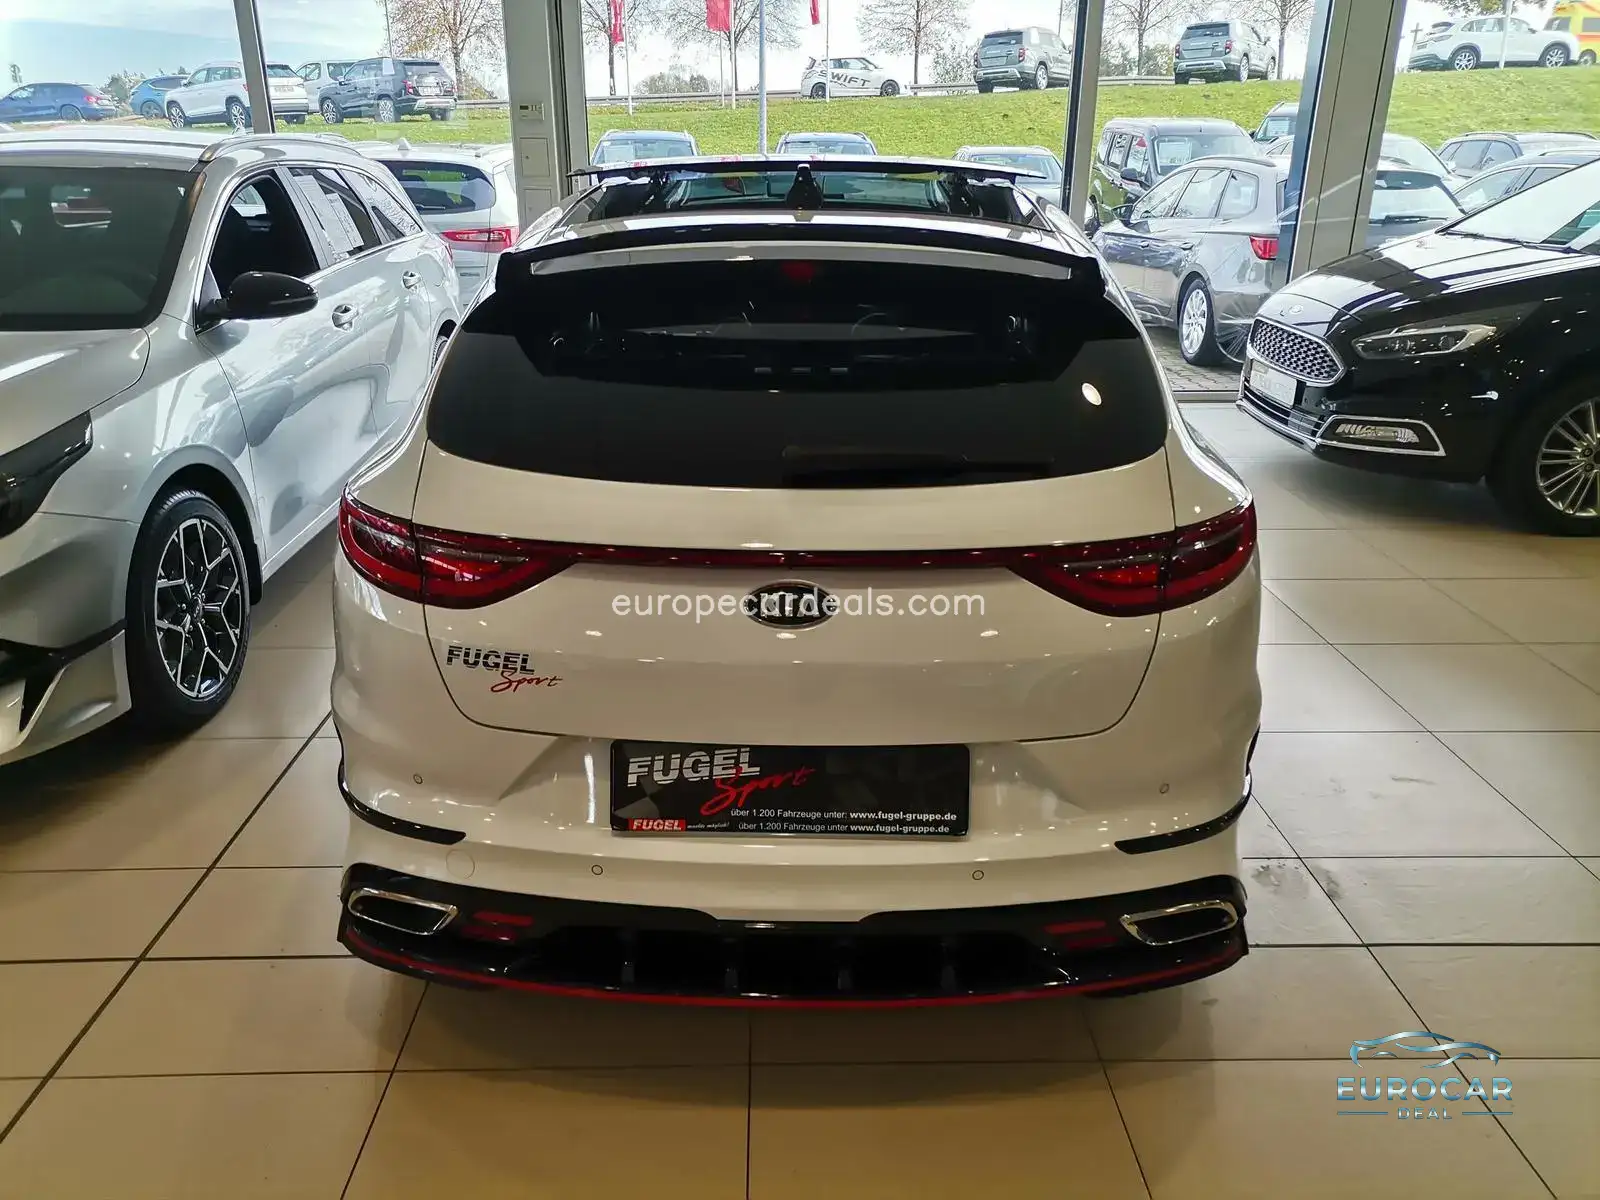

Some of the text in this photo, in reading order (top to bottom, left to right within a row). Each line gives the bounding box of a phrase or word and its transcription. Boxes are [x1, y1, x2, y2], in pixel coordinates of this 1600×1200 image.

[818, 70, 871, 87] SWIFT
[446, 645, 535, 675] FUGEL
[490, 669, 563, 692] Sport
[627, 747, 761, 787] FUGEL
[700, 765, 816, 816] Sport
[632, 819, 682, 831] FUGEL
[731, 808, 749, 817] über
[753, 809, 775, 818] 1.200
[778, 810, 822, 820] Fahrzeuge
[850, 810, 957, 822] www.fugel-gruppe.de
[738, 822, 757, 830] über
[759, 822, 781, 831] 1.200
[784, 822, 825, 832] Fahrzeuge
[850, 823, 950, 834] www.fugel-gruppe.de
